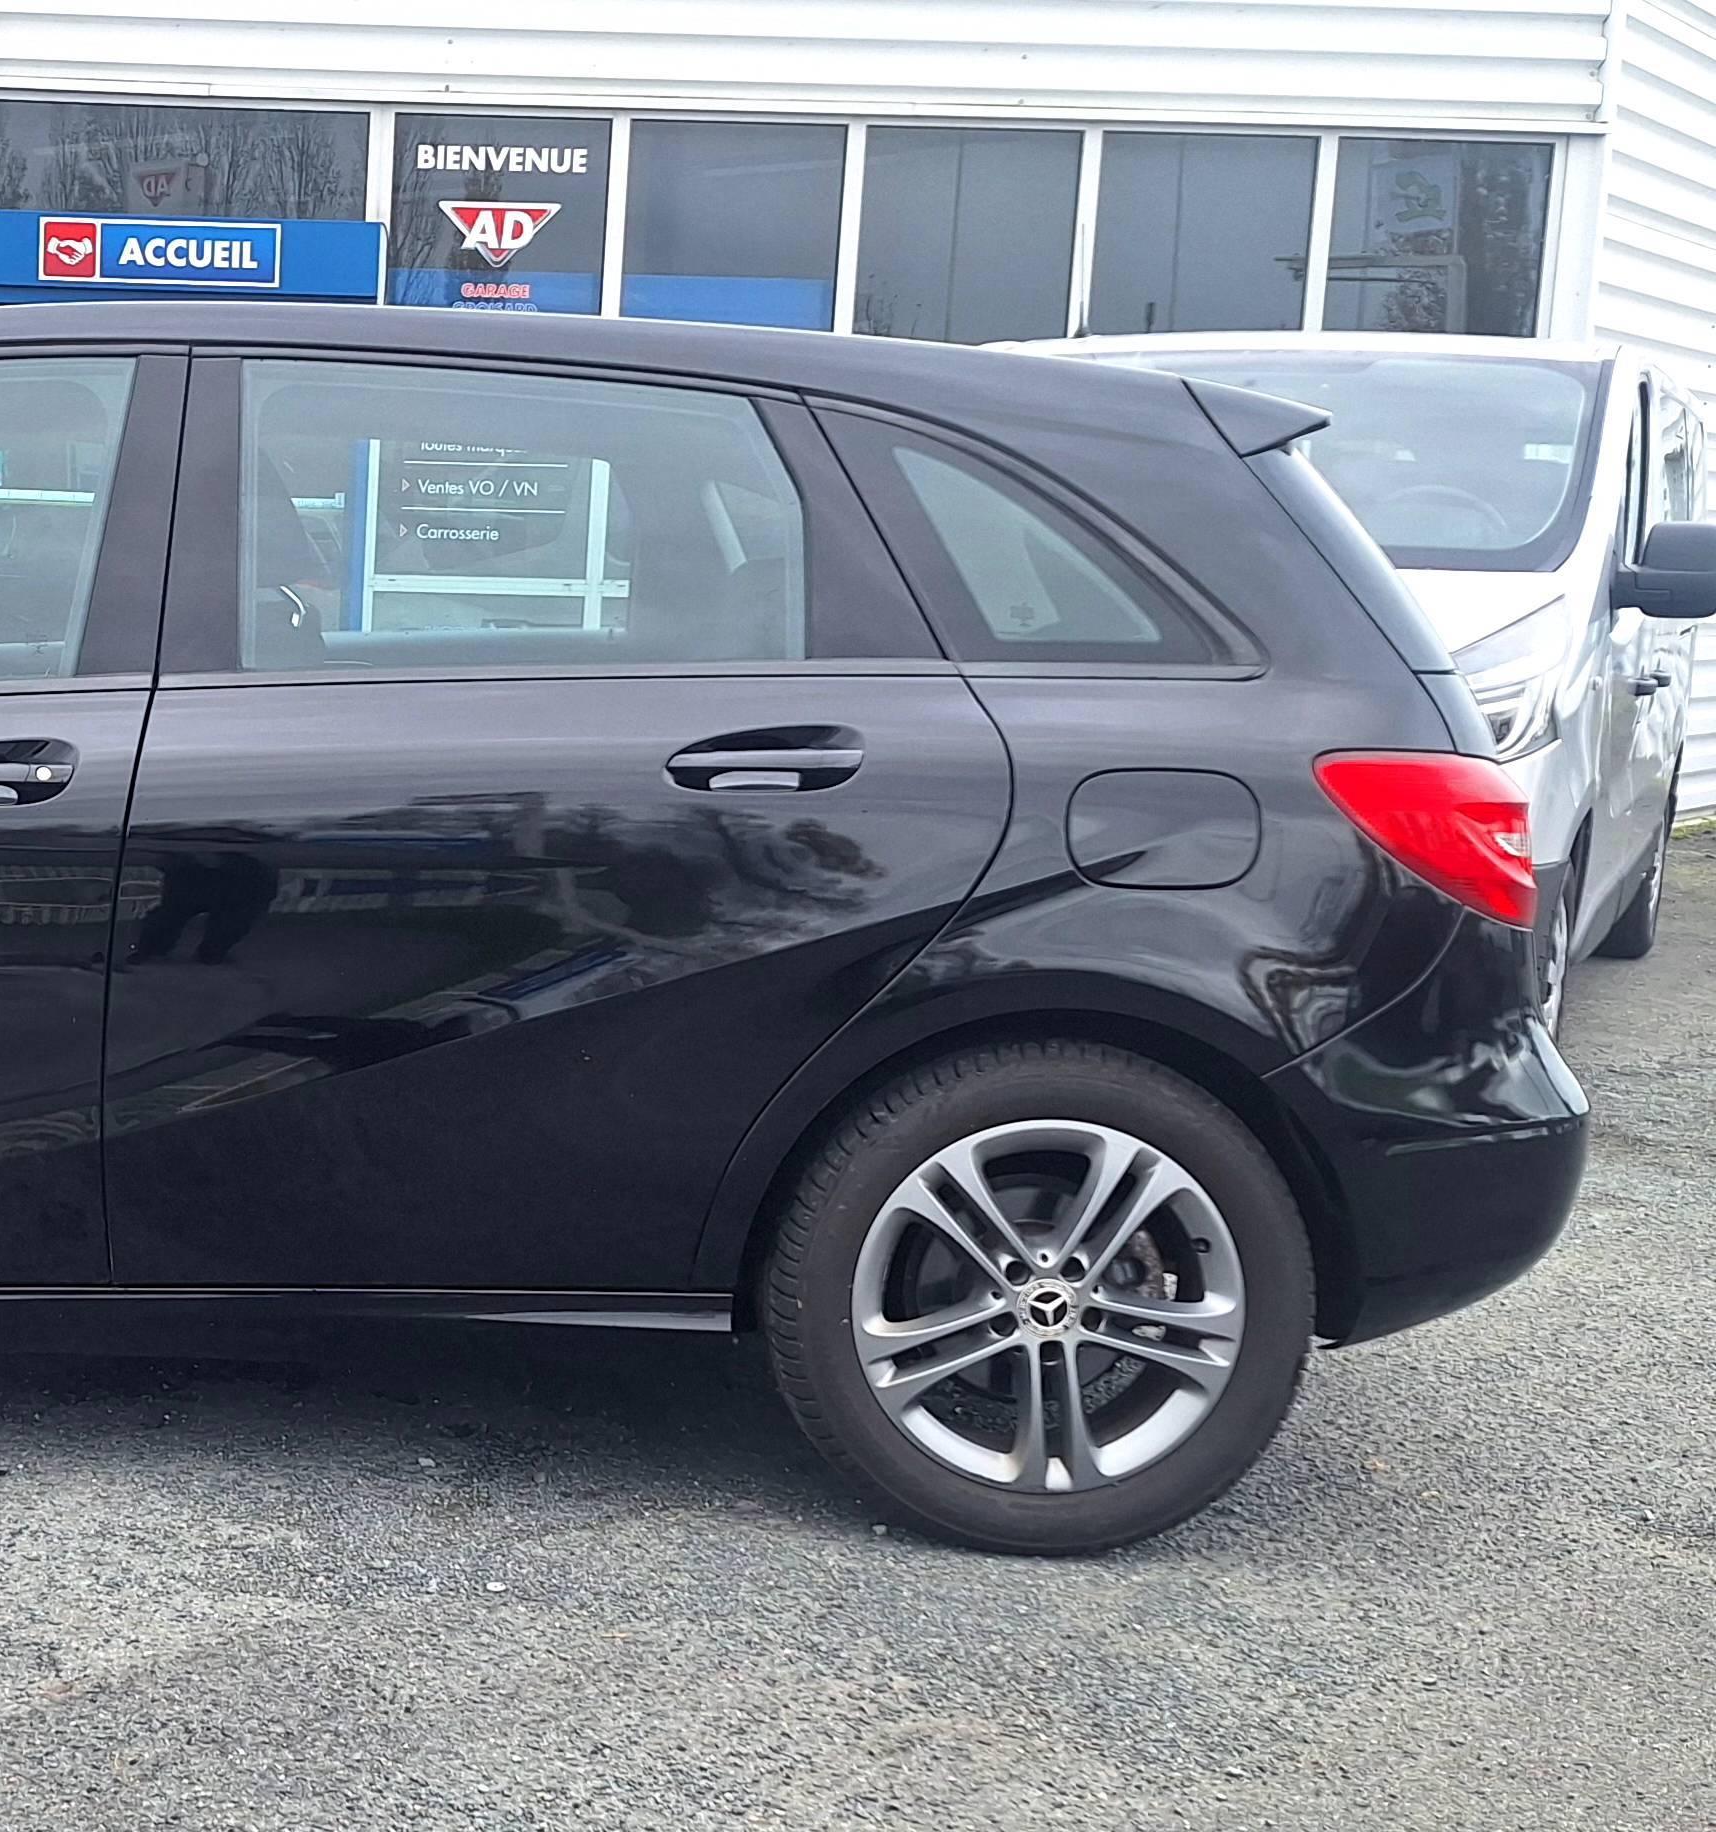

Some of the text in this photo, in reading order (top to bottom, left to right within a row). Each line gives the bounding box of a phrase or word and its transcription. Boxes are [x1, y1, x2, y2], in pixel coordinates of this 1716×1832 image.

[417, 144, 588, 173] BIENVENUE
[461, 210, 535, 250] AD
[118, 237, 259, 269] ACCUEIL
[461, 282, 530, 299] GARAGE
[418, 479, 538, 498] Ventes VO / VN
[416, 523, 499, 541] Carrosserie
